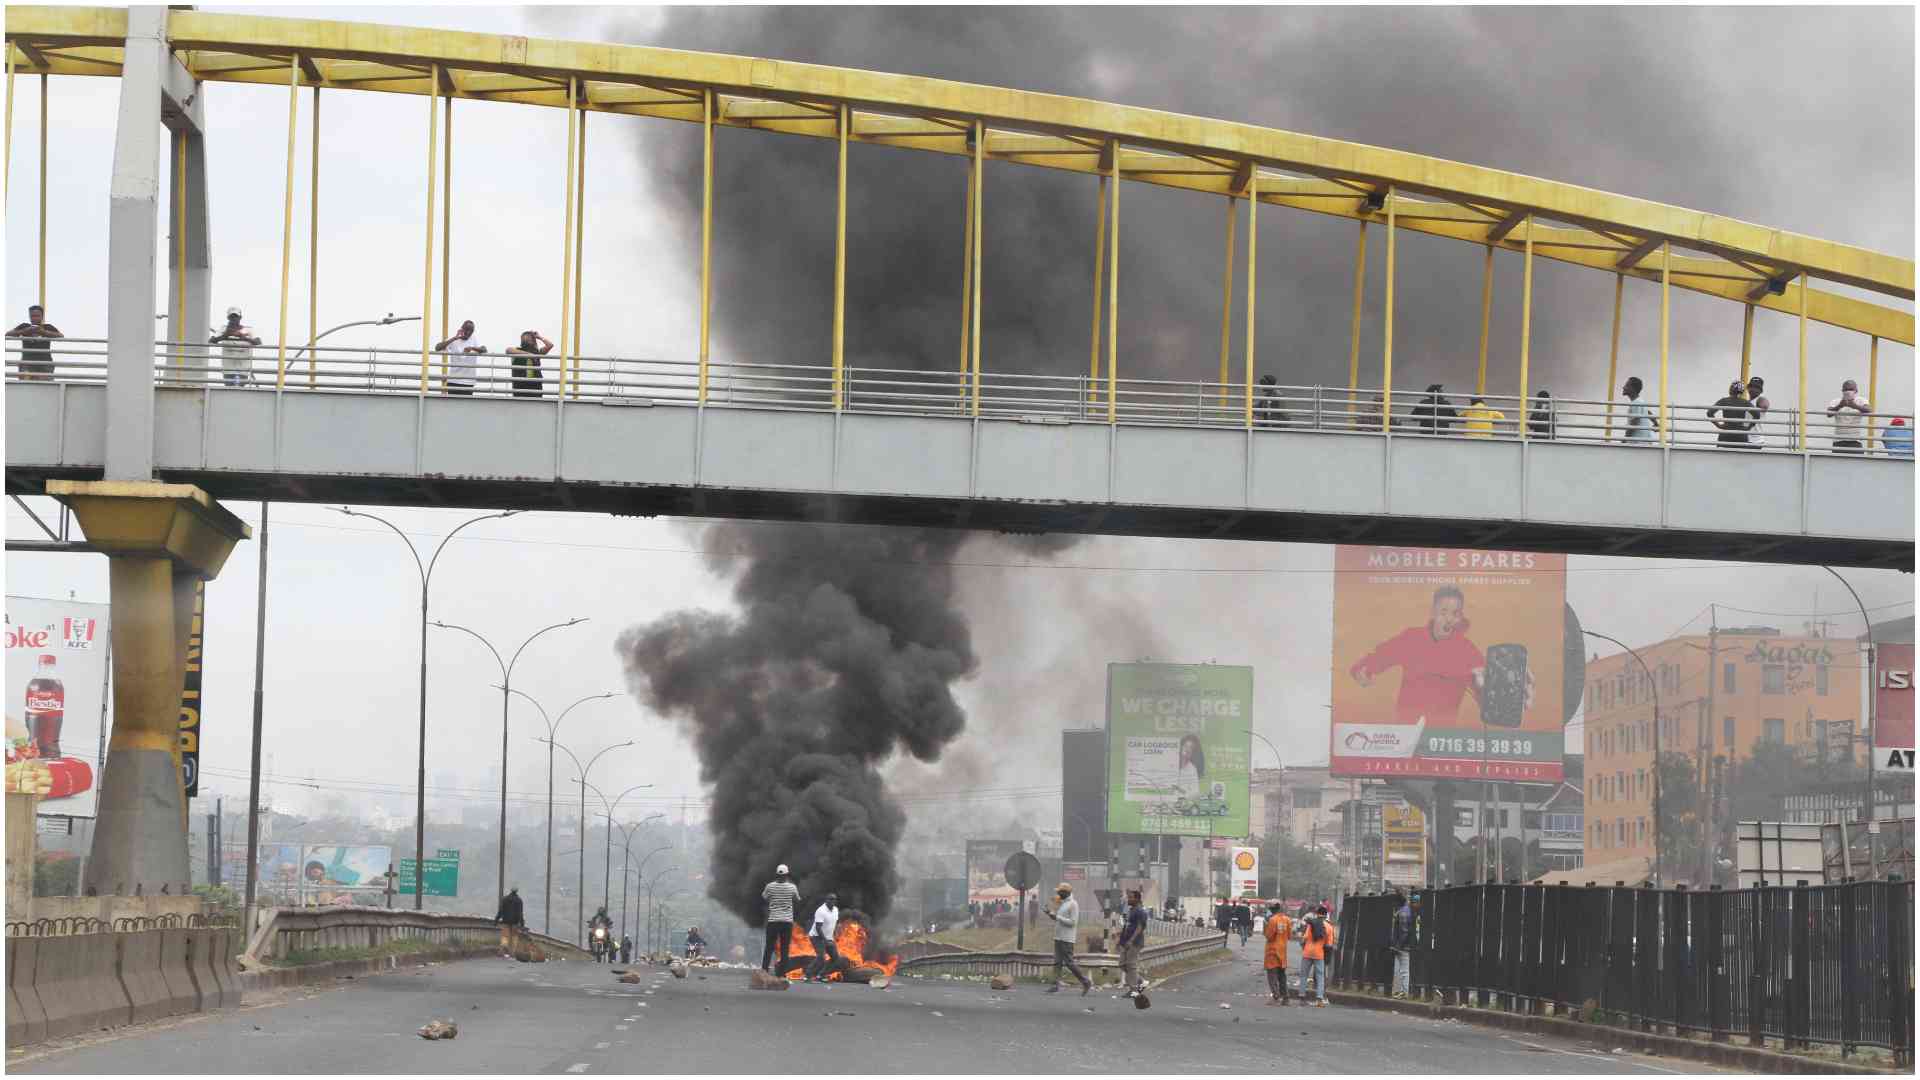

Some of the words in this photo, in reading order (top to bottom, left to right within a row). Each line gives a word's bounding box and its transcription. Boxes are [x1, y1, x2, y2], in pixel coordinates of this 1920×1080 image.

[1368, 552, 1447, 568] MOBILE
[1458, 552, 1536, 569] SPARES
[67, 641, 89, 649] KFC
[1879, 670, 1915, 689] IS
[1121, 697, 1153, 714] WE
[1157, 698, 1241, 717] CHARGE
[1429, 737, 1462, 752] 0716
[1466, 738, 1485, 753] 39
[1491, 739, 1511, 754] 39
[1513, 740, 1532, 755] 39
[1435, 763, 1461, 773] AND
[1476, 765, 1539, 776] REPAIRS
